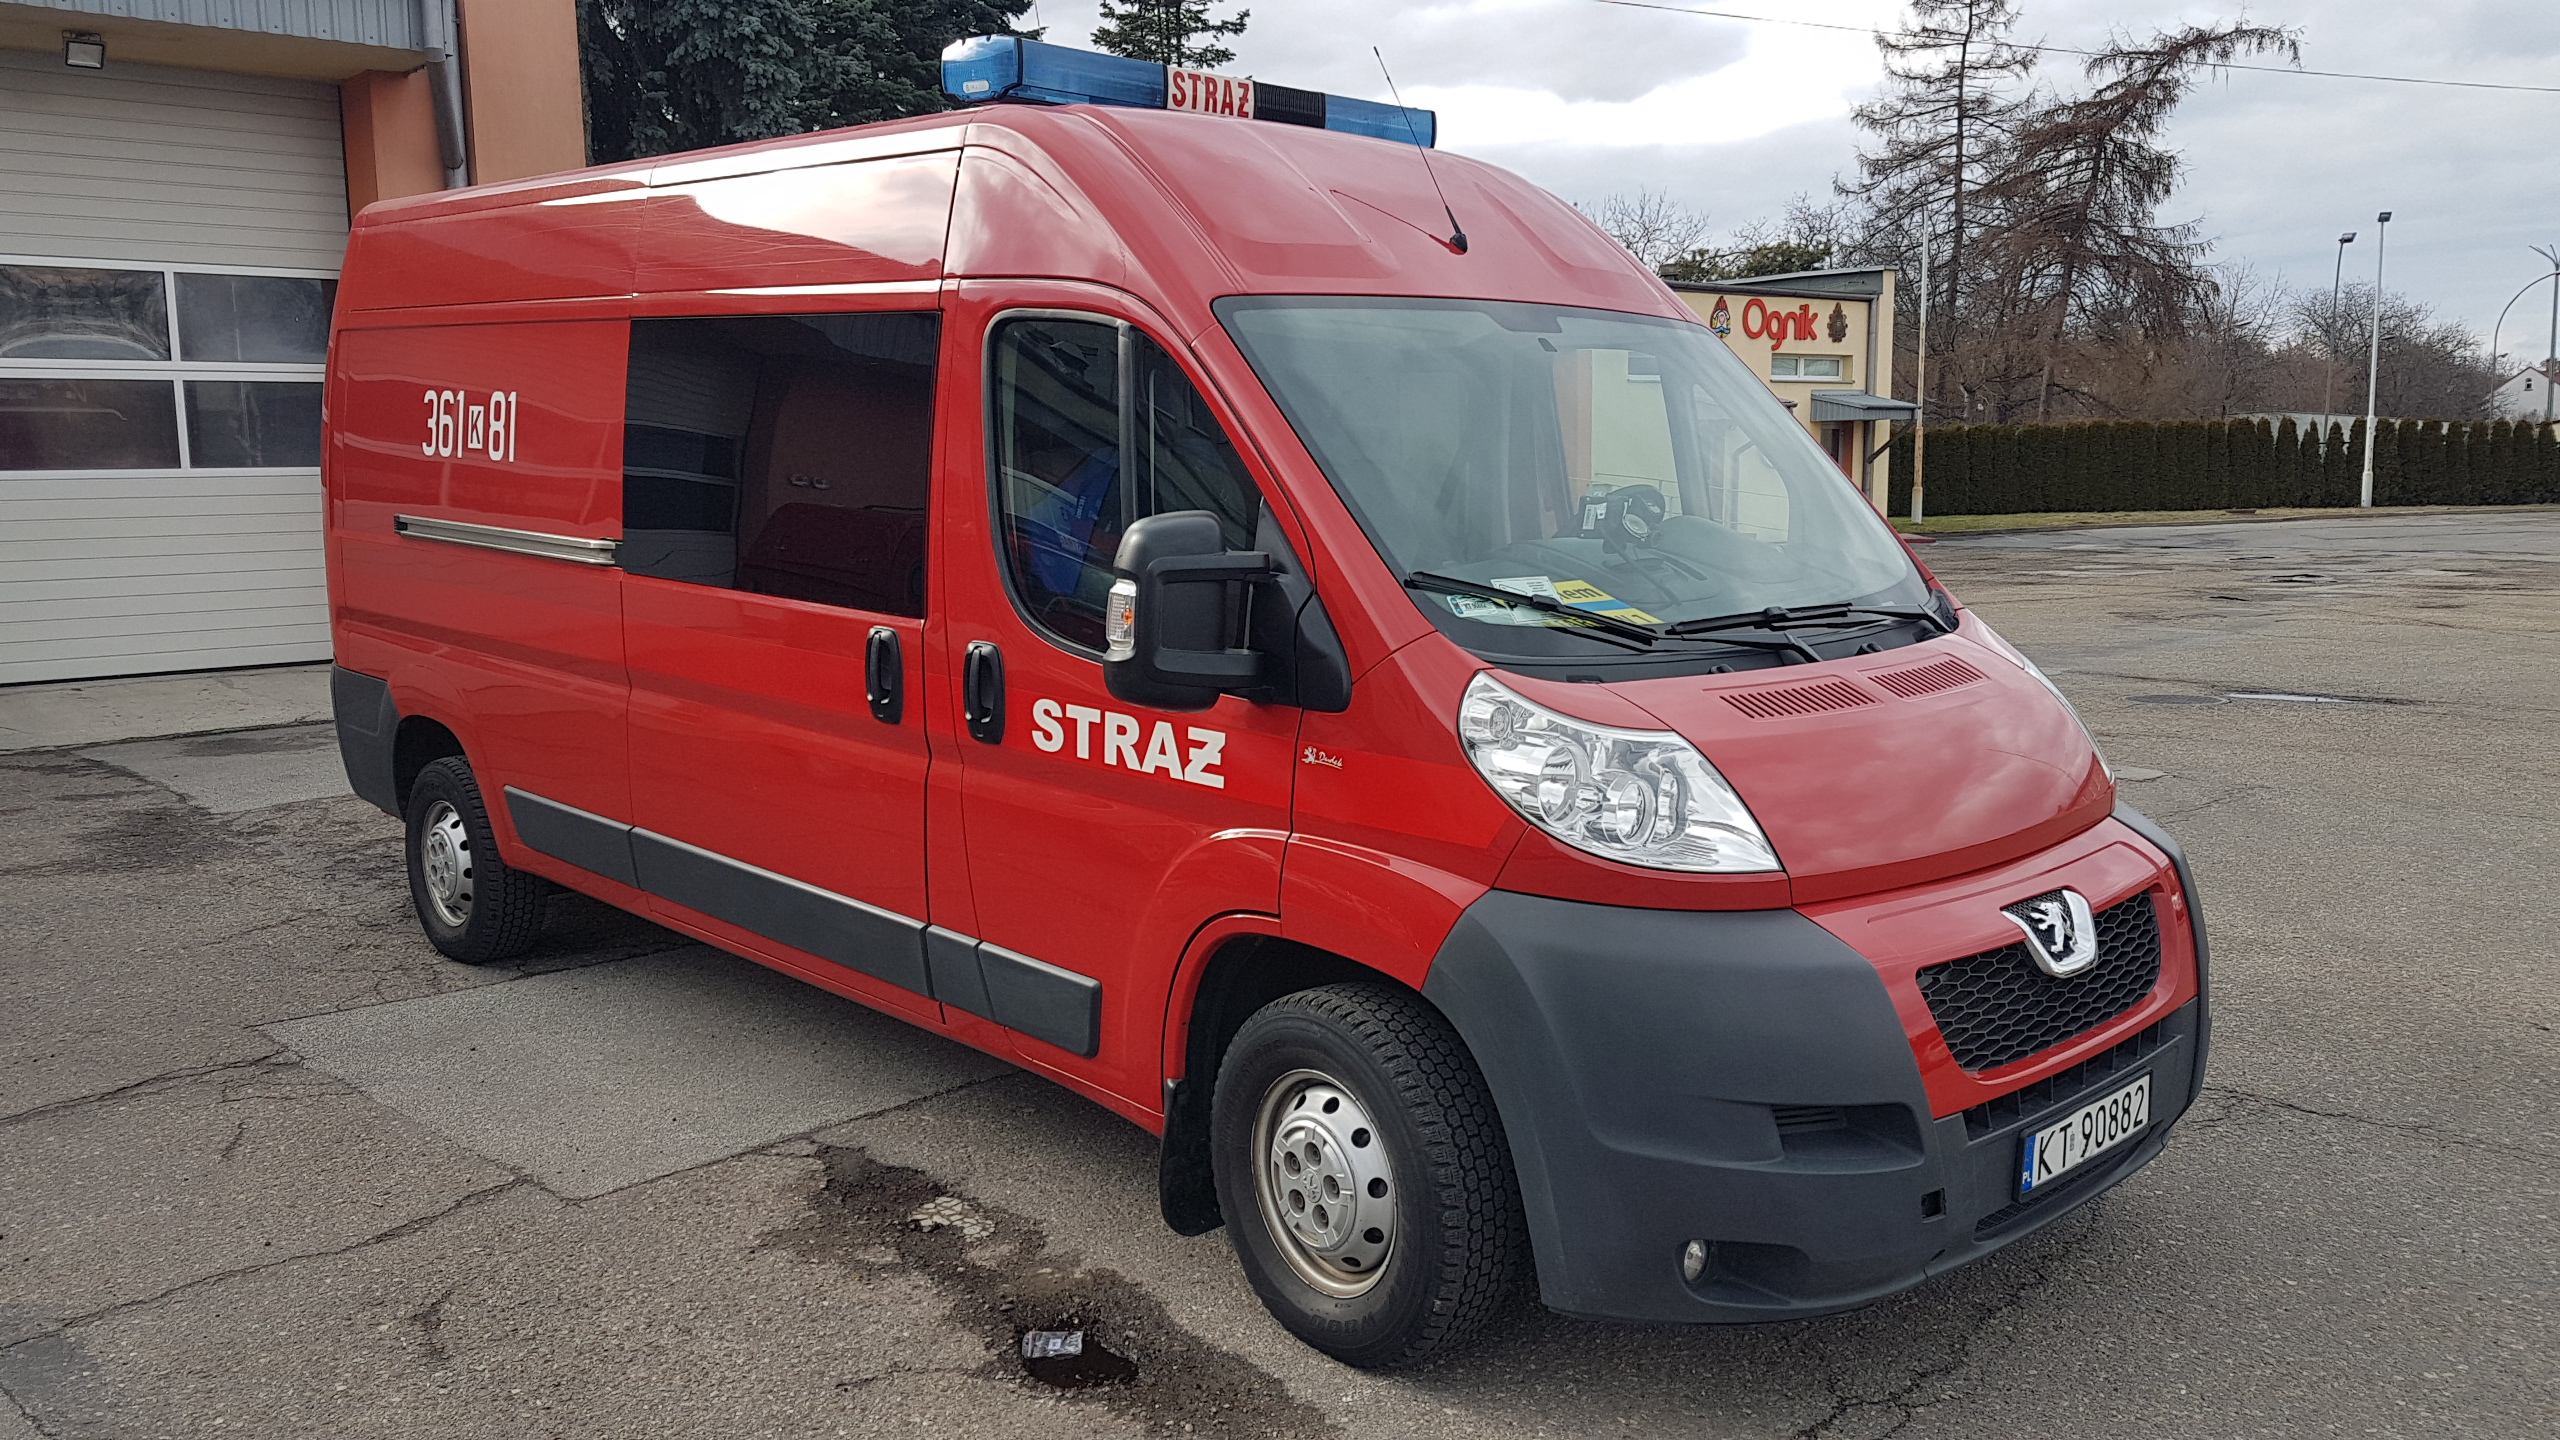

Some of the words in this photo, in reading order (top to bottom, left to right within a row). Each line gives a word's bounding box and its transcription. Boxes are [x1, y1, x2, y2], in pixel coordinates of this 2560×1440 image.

[1742, 298, 1819, 351] Ognik
[422, 389, 465, 459] 361
[469, 408, 483, 446] K
[488, 390, 517, 462] 81
[2037, 1121, 2073, 1181] KT
[2080, 1084, 2145, 1158] 90882
[2022, 1171, 2032, 1185] PL
